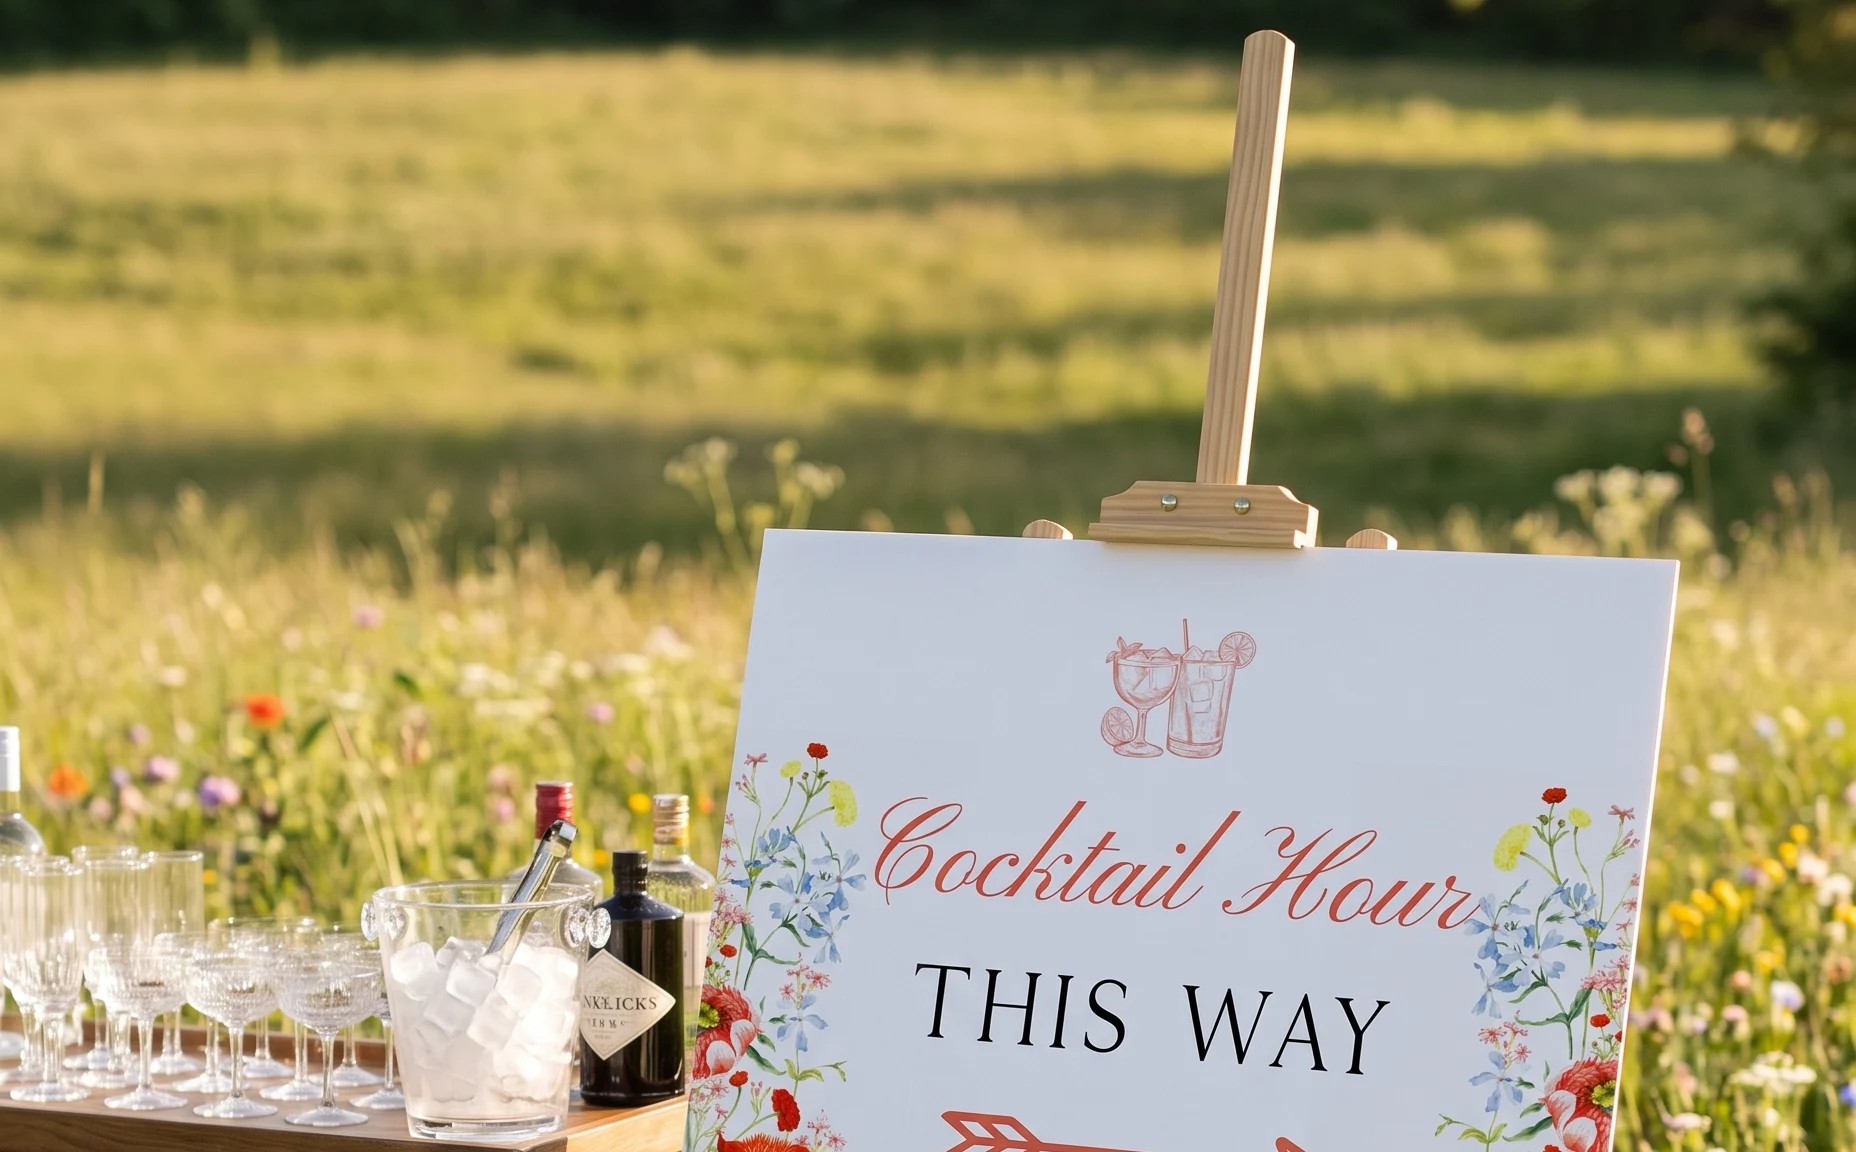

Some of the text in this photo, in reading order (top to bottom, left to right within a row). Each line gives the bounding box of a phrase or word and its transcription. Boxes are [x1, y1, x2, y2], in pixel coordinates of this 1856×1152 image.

[873, 796, 1480, 931] Cocktail Hour
[914, 963, 1391, 1076] THIS WAY
